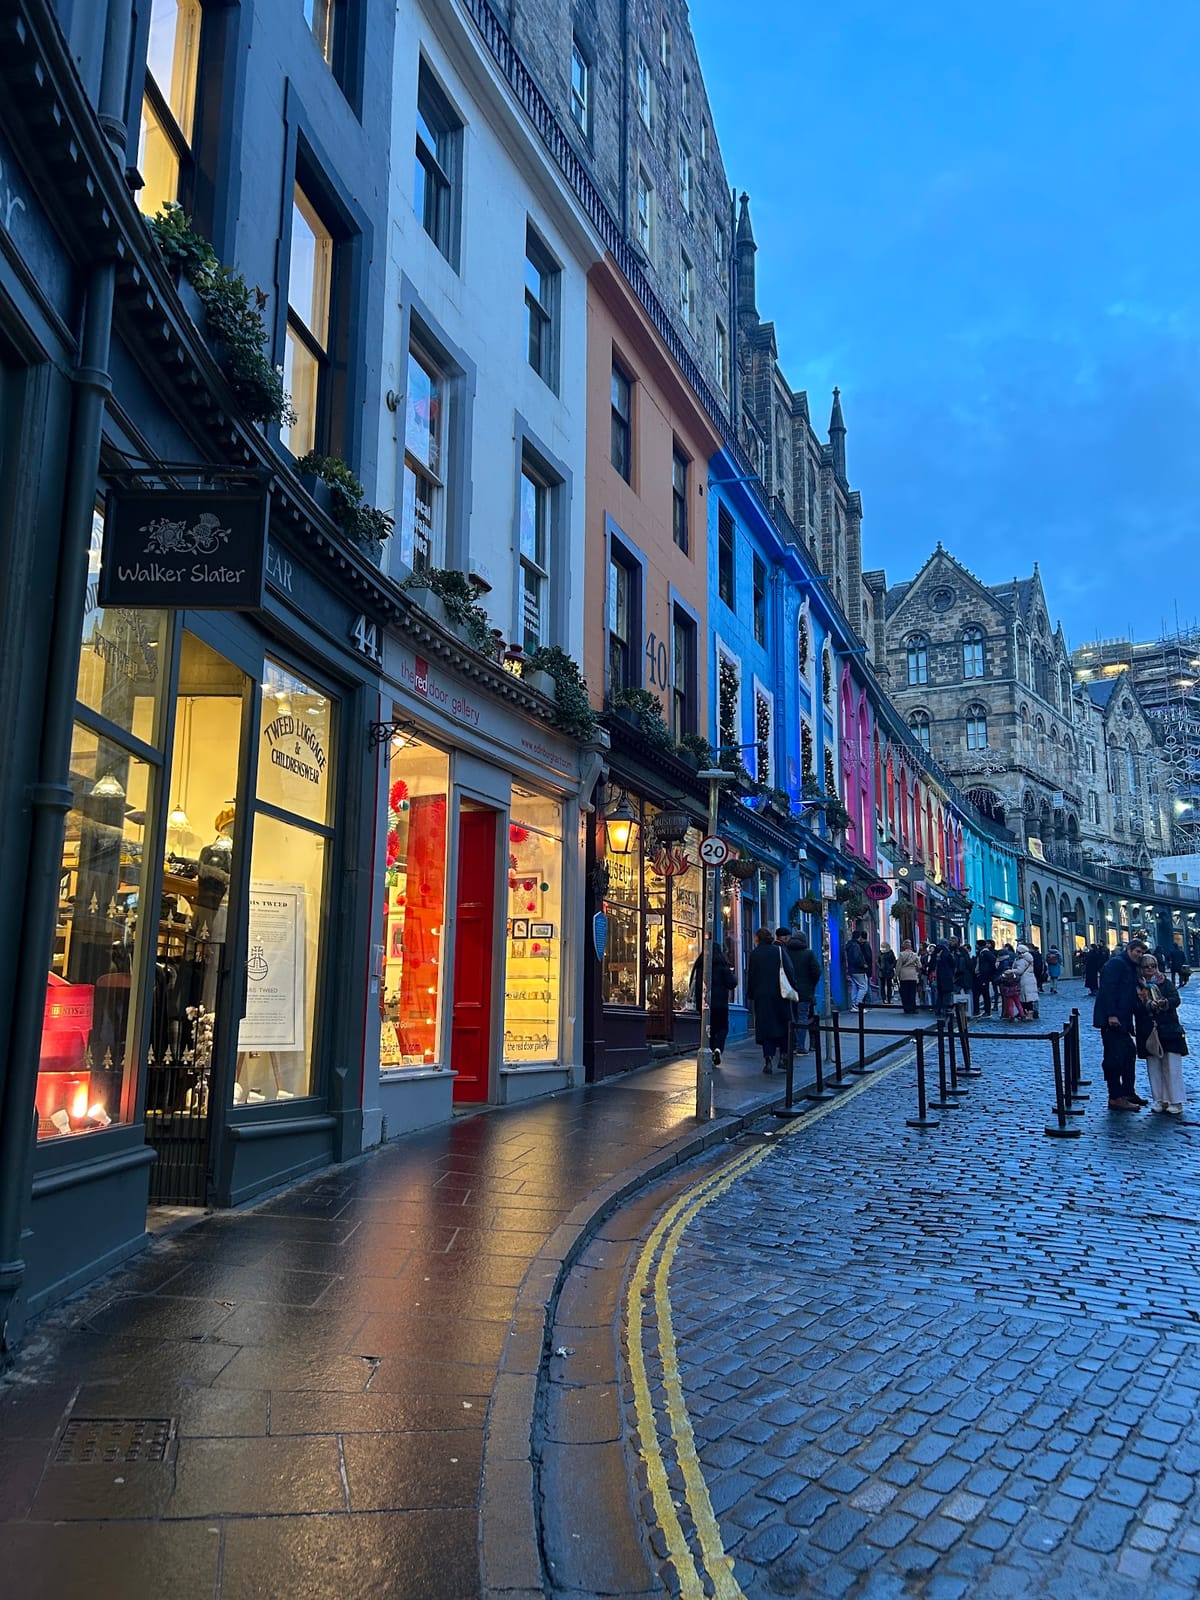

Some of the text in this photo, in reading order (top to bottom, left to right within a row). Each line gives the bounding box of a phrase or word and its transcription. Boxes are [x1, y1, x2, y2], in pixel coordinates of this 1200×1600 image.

[118, 562, 246, 583] Walker Slater
[265, 543, 293, 592] EAR
[401, 660, 480, 725] the red door gallery
[264, 715, 327, 773] TWEED LUGGAGE
[294, 741, 301, 755] &
[271, 748, 320, 784] CHILDRENSWEAR
[703, 843, 725, 858] 20
